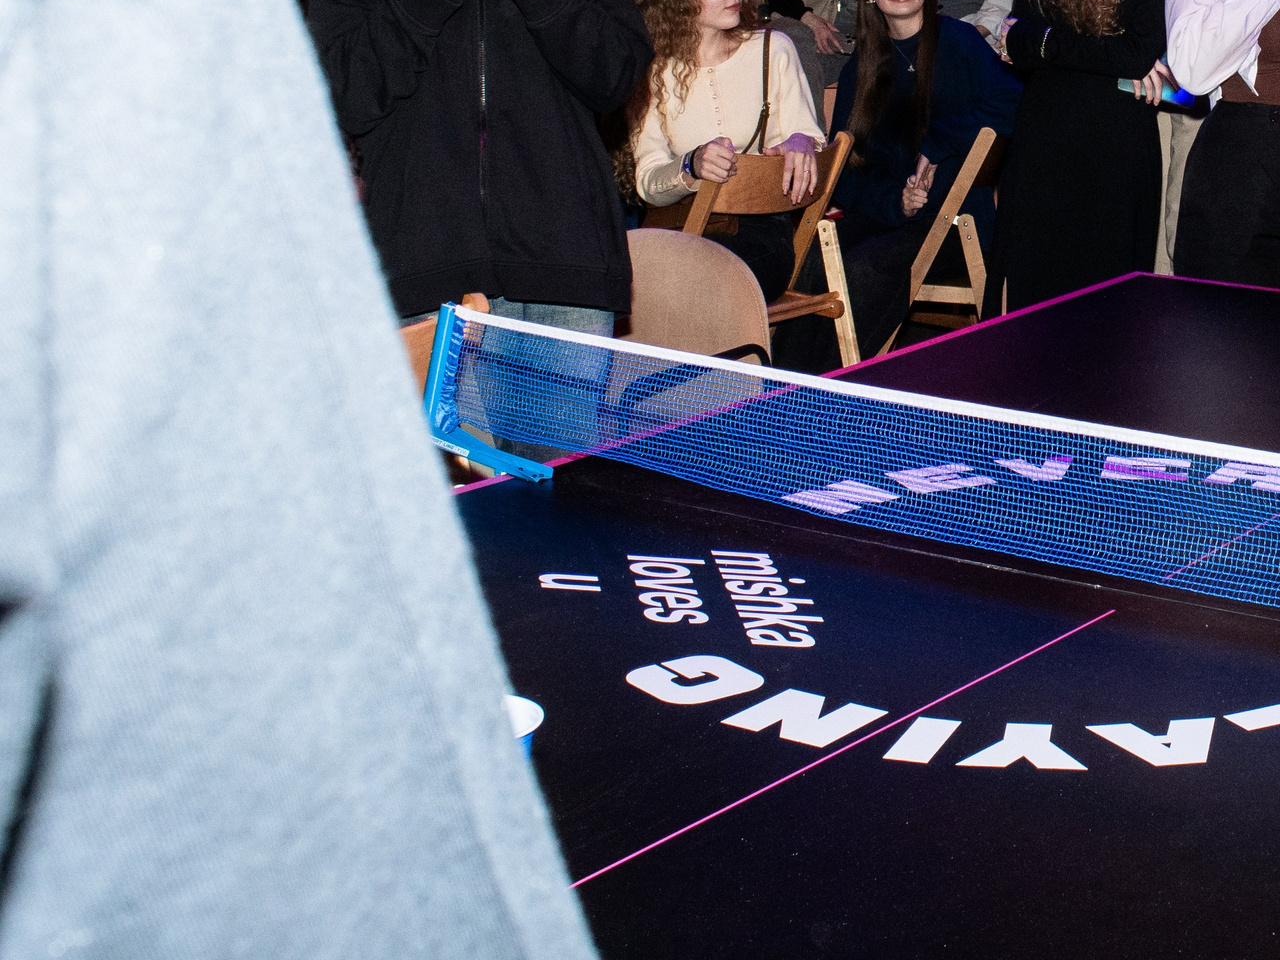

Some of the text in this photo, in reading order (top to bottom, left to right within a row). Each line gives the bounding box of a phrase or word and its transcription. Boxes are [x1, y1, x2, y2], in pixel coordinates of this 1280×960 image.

[537, 572, 602, 592] u
[626, 553, 710, 625] loves
[710, 549, 825, 648] mishka
